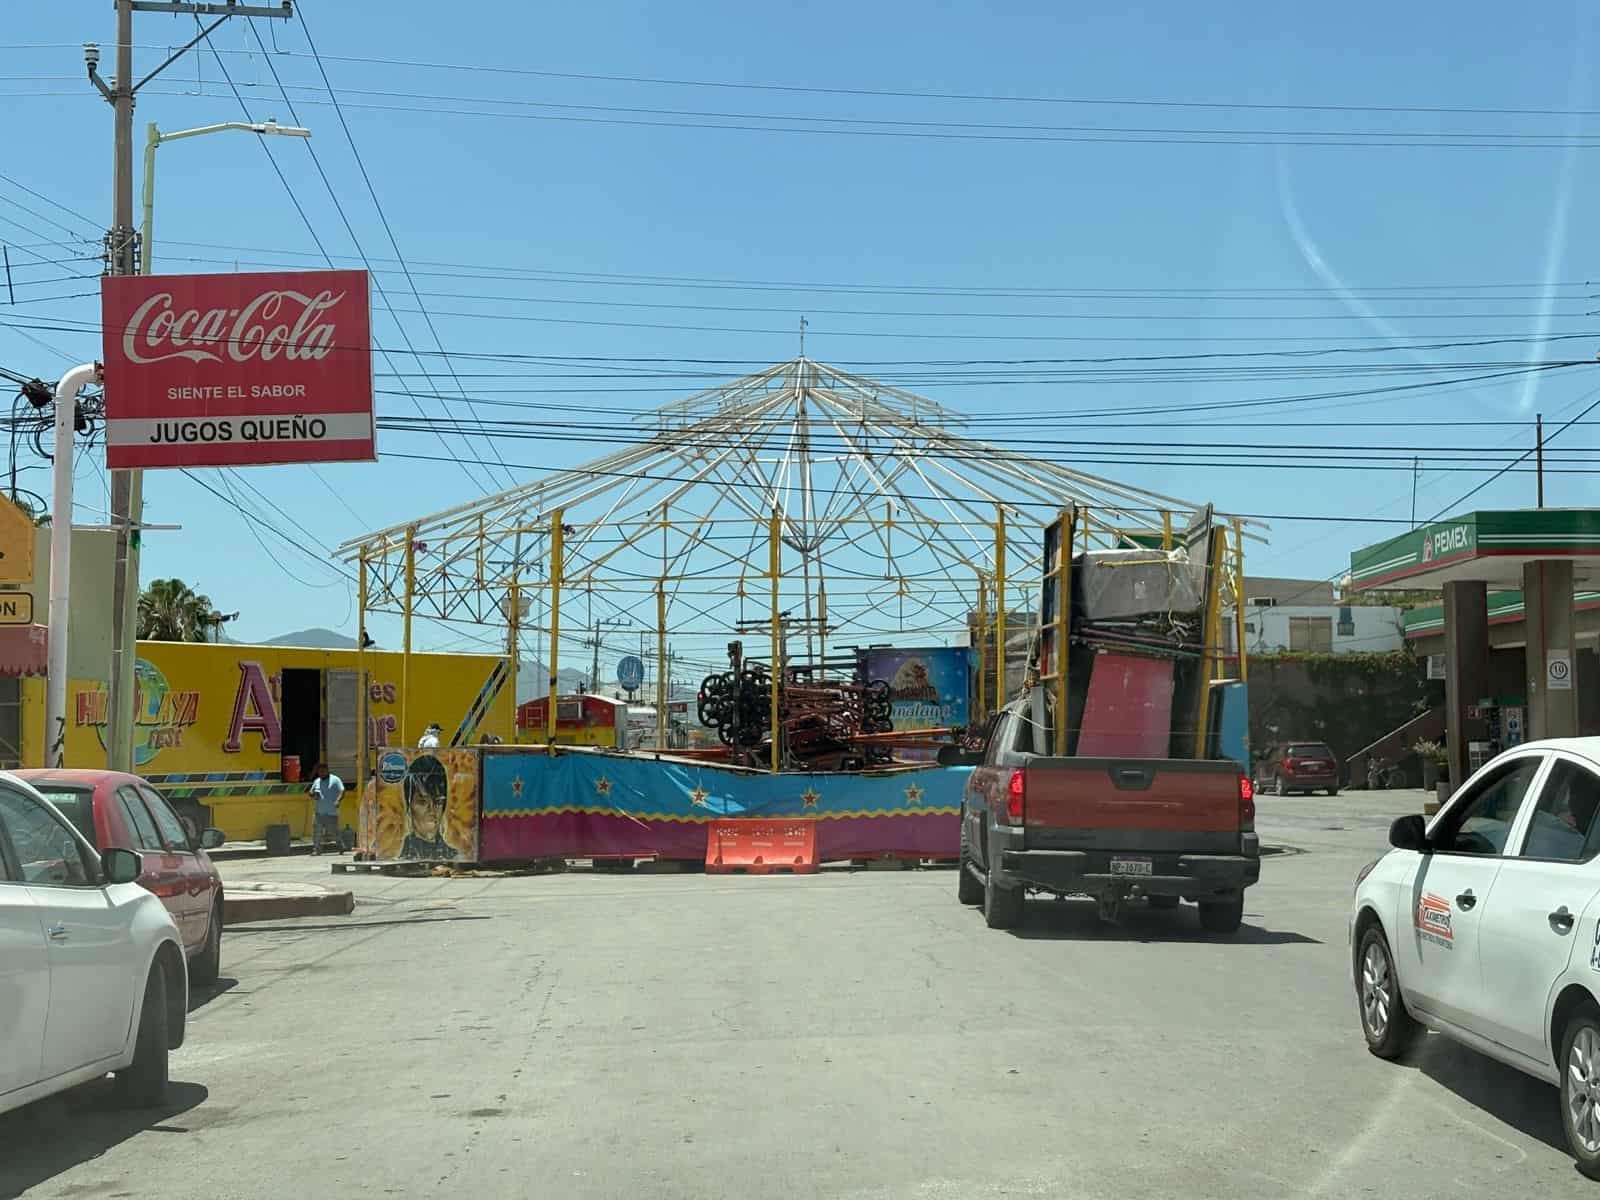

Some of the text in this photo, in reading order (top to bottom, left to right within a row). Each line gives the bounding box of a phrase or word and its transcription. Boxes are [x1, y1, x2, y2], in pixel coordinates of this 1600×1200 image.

[122, 290, 346, 364] Coca-Cola
[167, 384, 306, 400] SIENTE EL SABOR
[150, 414, 327, 443] JUGOS QUEÑO
[1434, 525, 1468, 554] PEMEX
